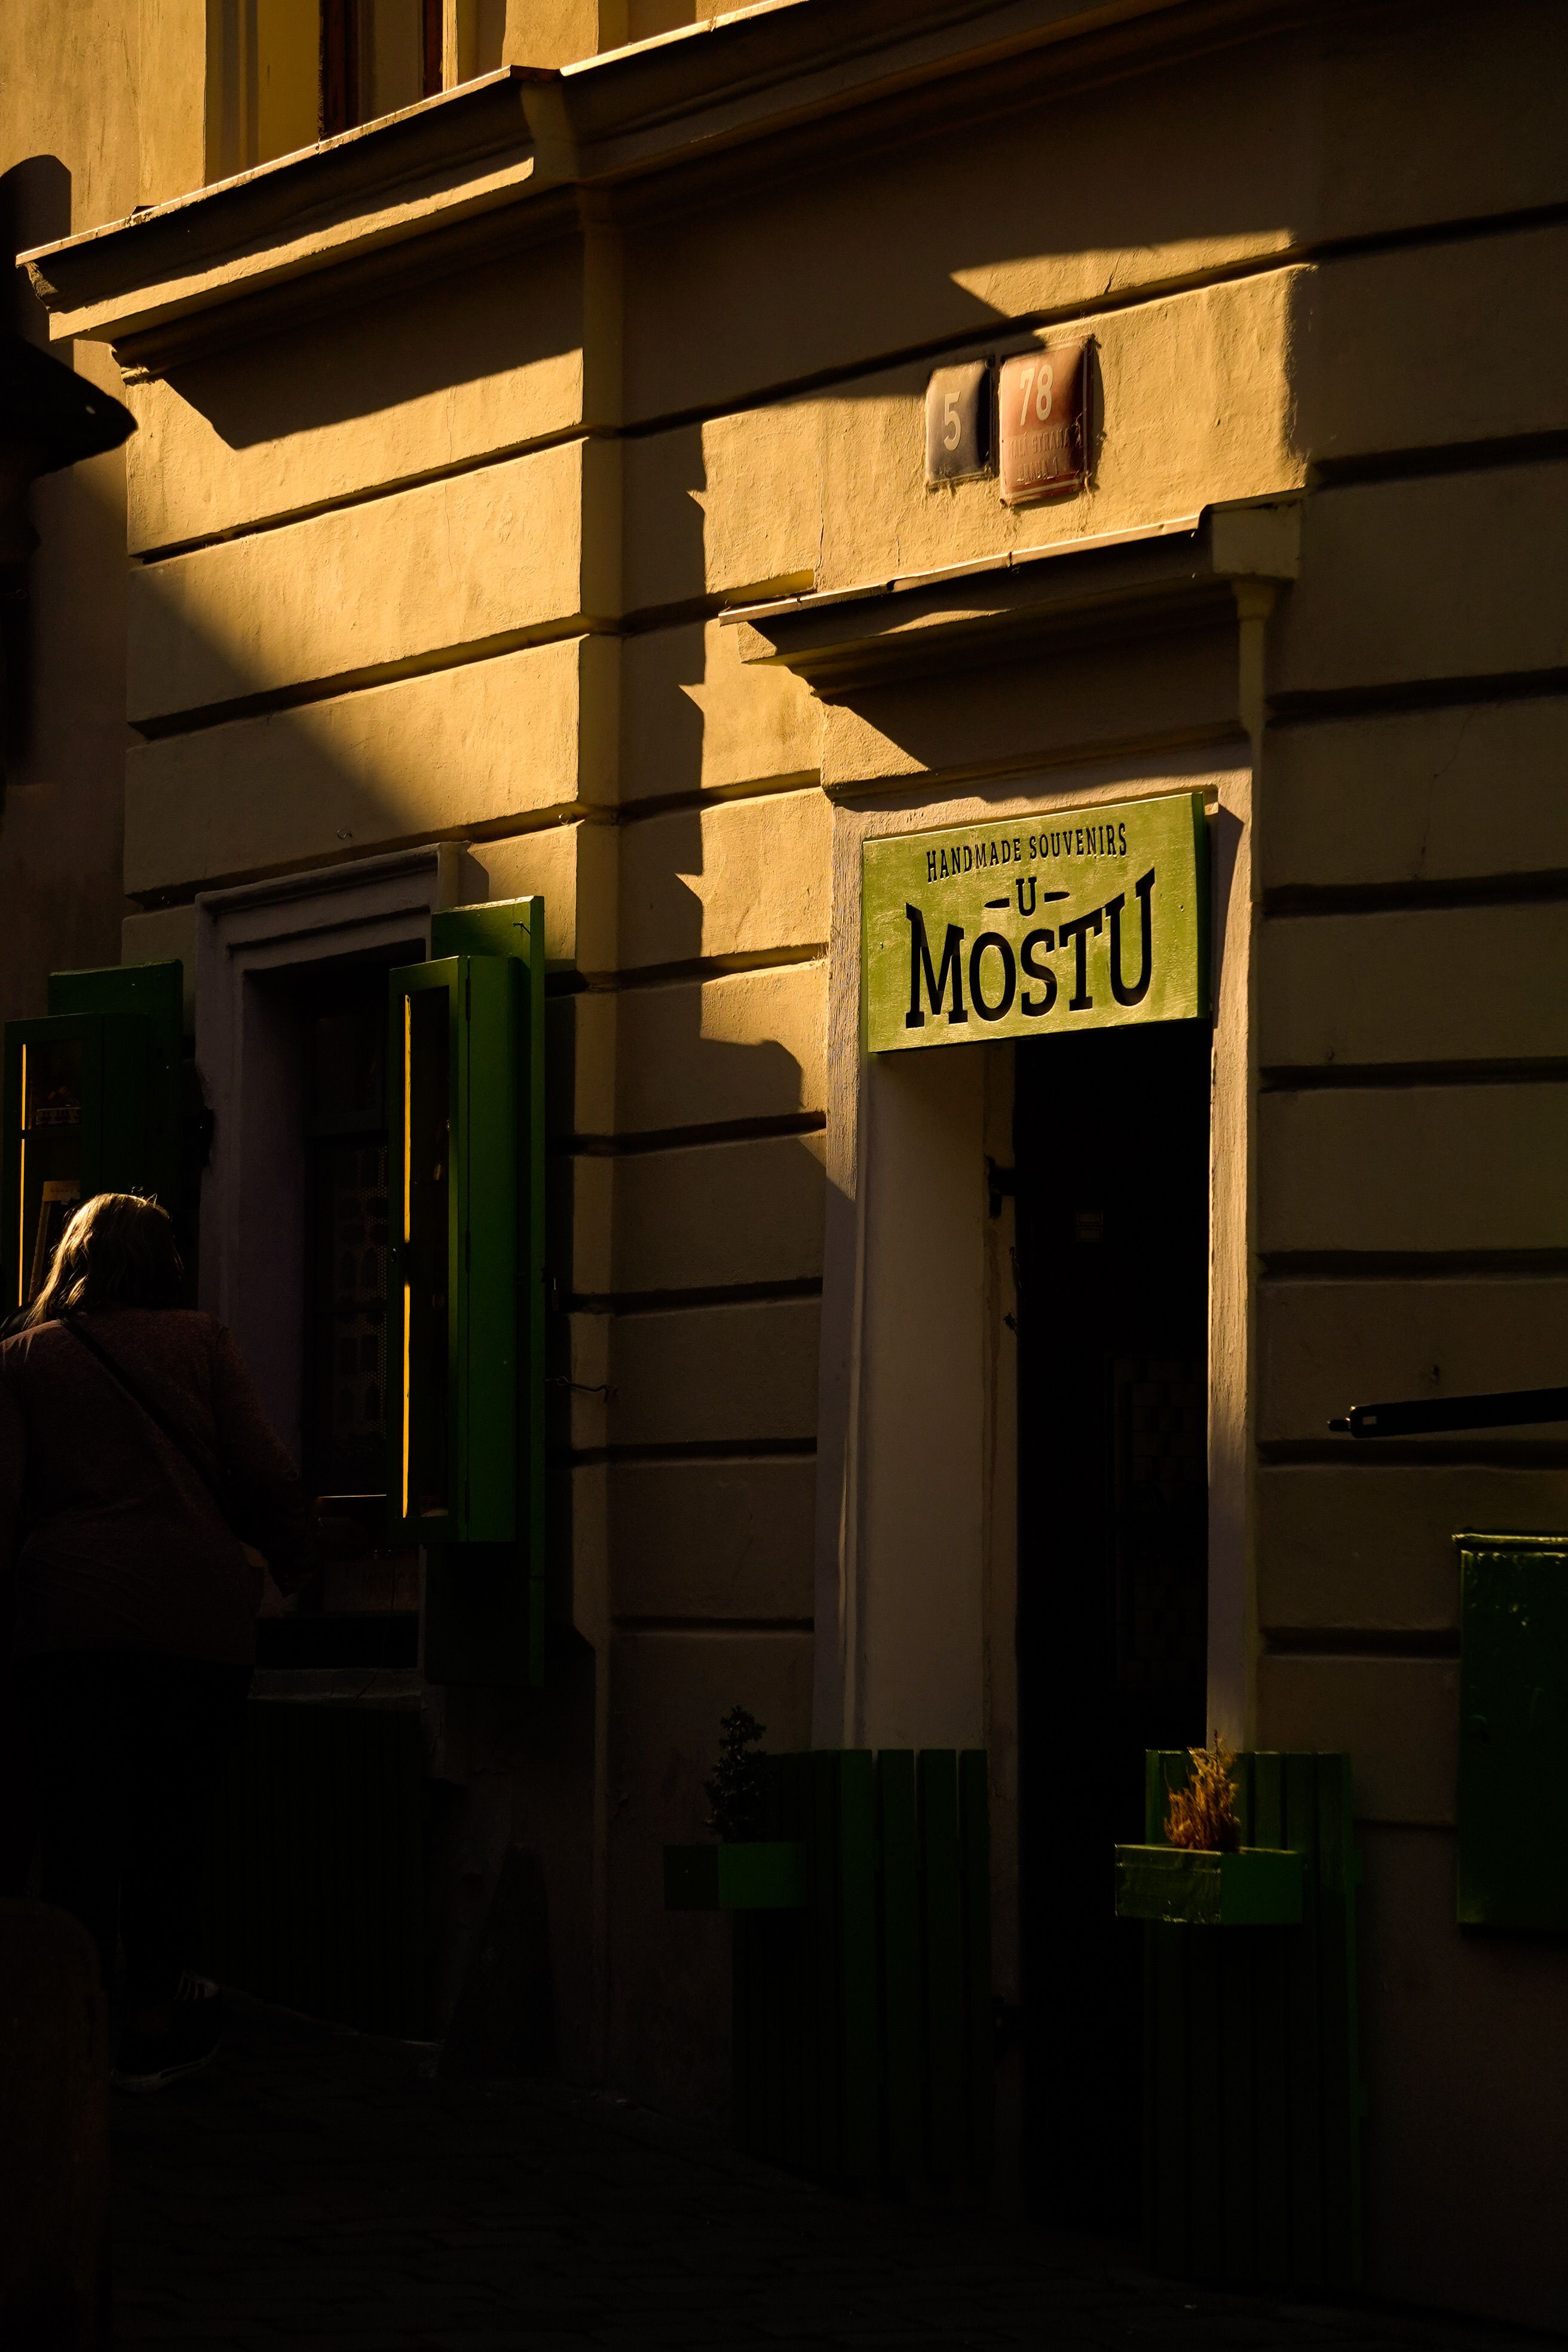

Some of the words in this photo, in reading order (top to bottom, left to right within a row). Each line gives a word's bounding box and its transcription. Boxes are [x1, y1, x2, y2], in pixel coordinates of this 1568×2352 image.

[943, 391, 961, 451] 5
[1019, 365, 1054, 426] 78
[926, 838, 1021, 883] HANDMADE
[1029, 822, 1127, 859] SOUVENIRS
[905, 866, 1155, 1029] MOSTU
